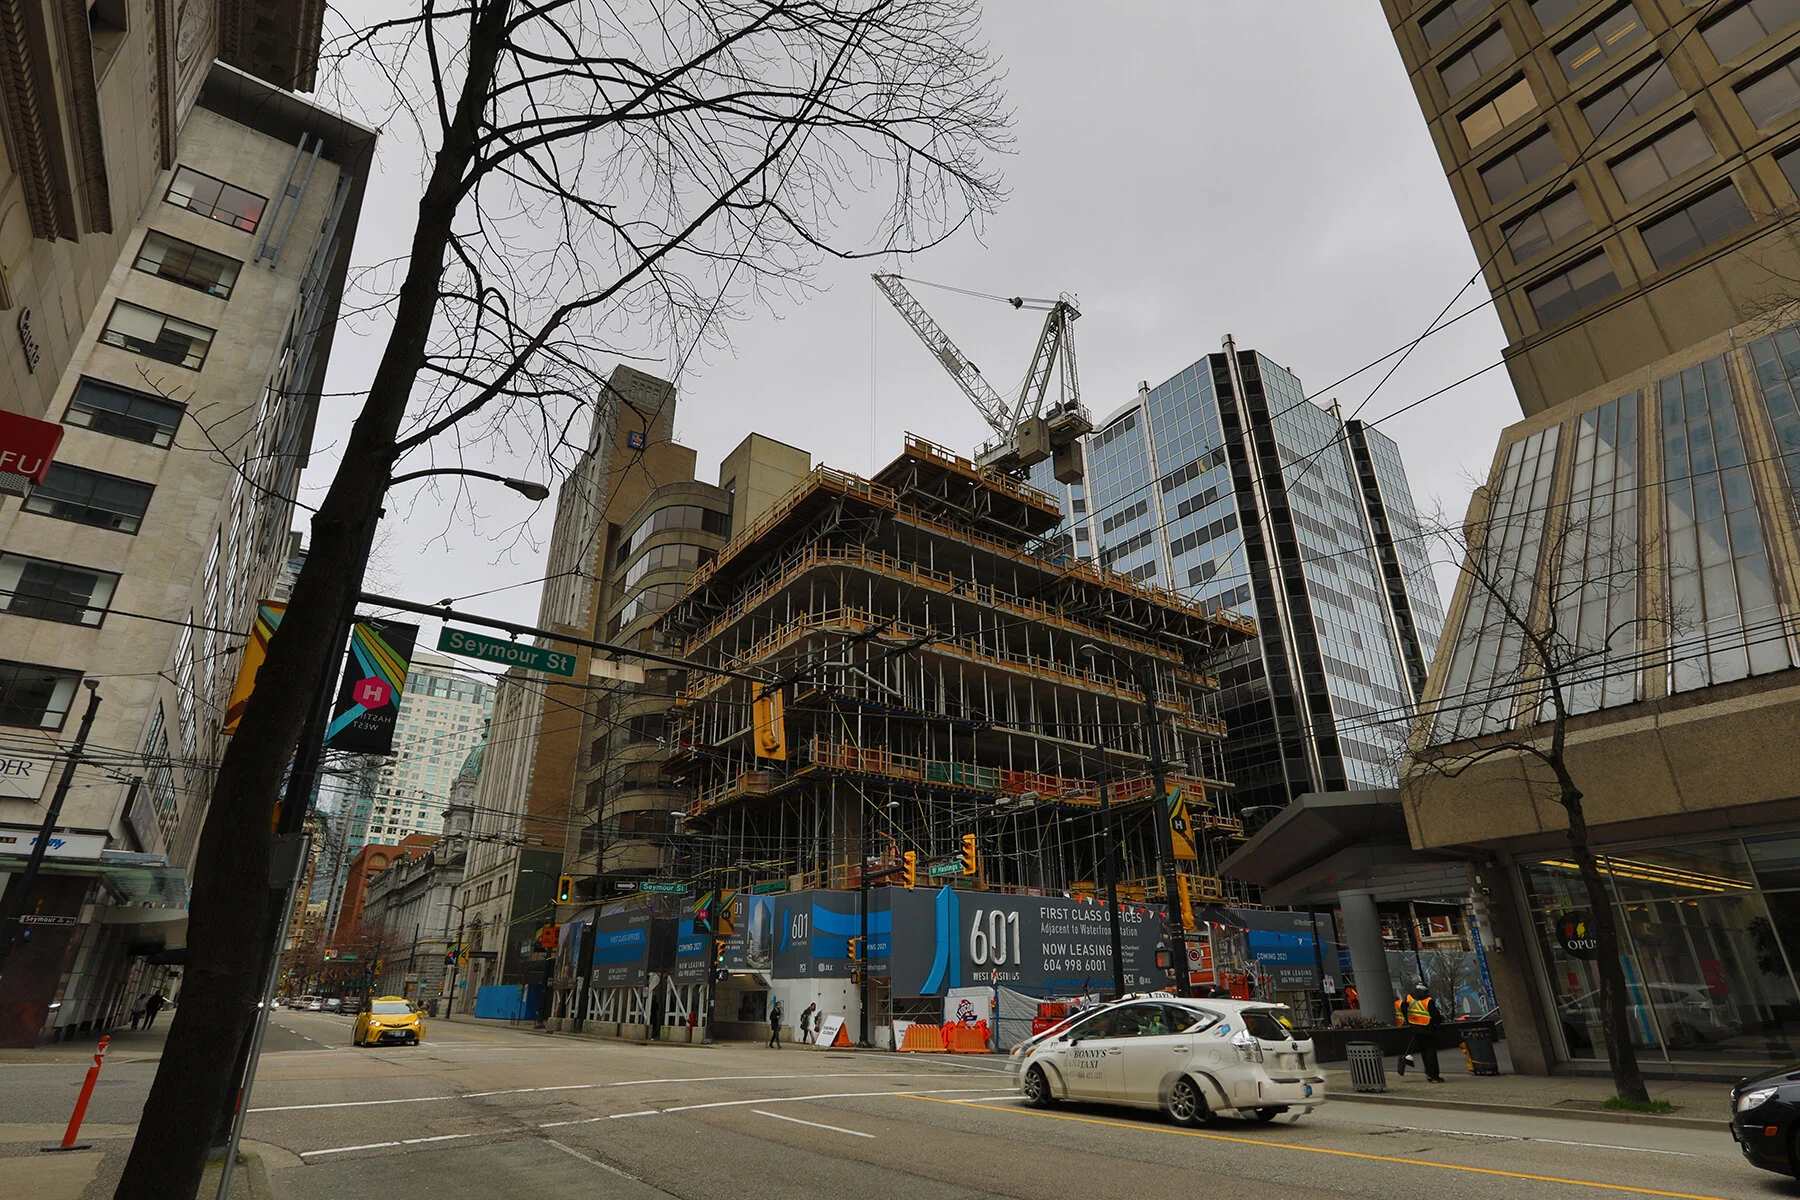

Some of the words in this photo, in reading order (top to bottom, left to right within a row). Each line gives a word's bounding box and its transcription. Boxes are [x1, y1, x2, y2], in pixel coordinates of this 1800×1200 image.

[449, 632, 539, 665] Seymour
[546, 653, 569, 671] St
[1174, 820, 1184, 830] H
[938, 863, 959, 873] Hastings
[643, 883, 674, 892] Seymour
[1040, 907, 1068, 920] FIRST
[1071, 909, 1102, 922] CLASS
[791, 914, 809, 940] 601
[1040, 922, 1070, 936] Adjacent
[1071, 924, 1079, 935] to
[1080, 924, 1112, 936] Waterfron
[1120, 926, 1139, 936] tation
[970, 909, 1021, 966] 601
[1042, 943, 1067, 956] NOW
[1070, 944, 1113, 956] LEASING
[1256, 952, 1277, 960] COMING
[1277, 953, 1288, 961] 2021
[1043, 959, 1061, 971] 604
[1064, 959, 1082, 971] 998
[1085, 959, 1107, 972] 6001
[972, 971, 990, 981] WEST
[1079, 1060, 1099, 1069] TAXI
